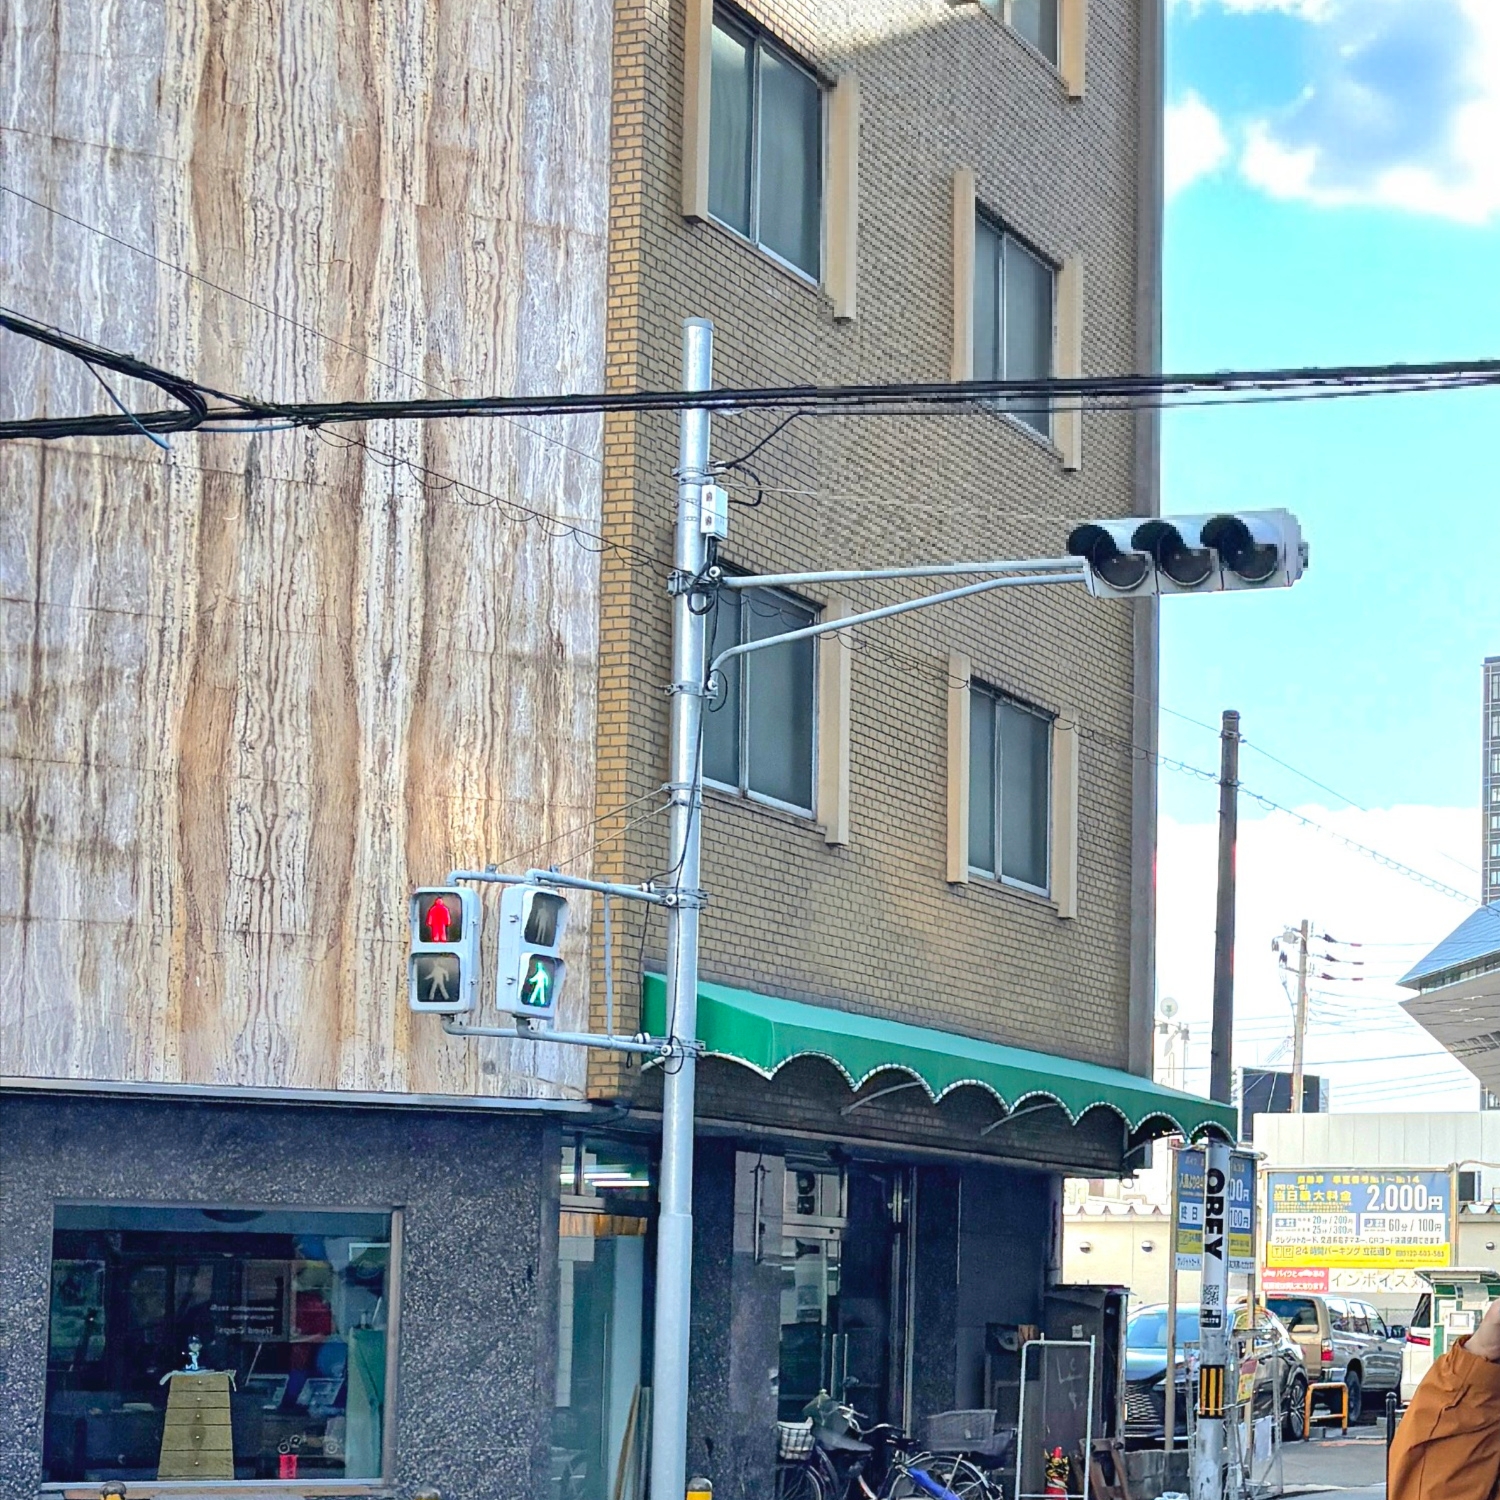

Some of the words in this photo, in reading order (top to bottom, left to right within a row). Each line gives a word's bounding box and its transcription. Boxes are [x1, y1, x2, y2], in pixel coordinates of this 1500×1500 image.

[1366, 1184, 1443, 1212] 2,000円
[1205, 1168, 1225, 1260] OBEY
[1331, 1272, 1430, 1291] インボイス対
